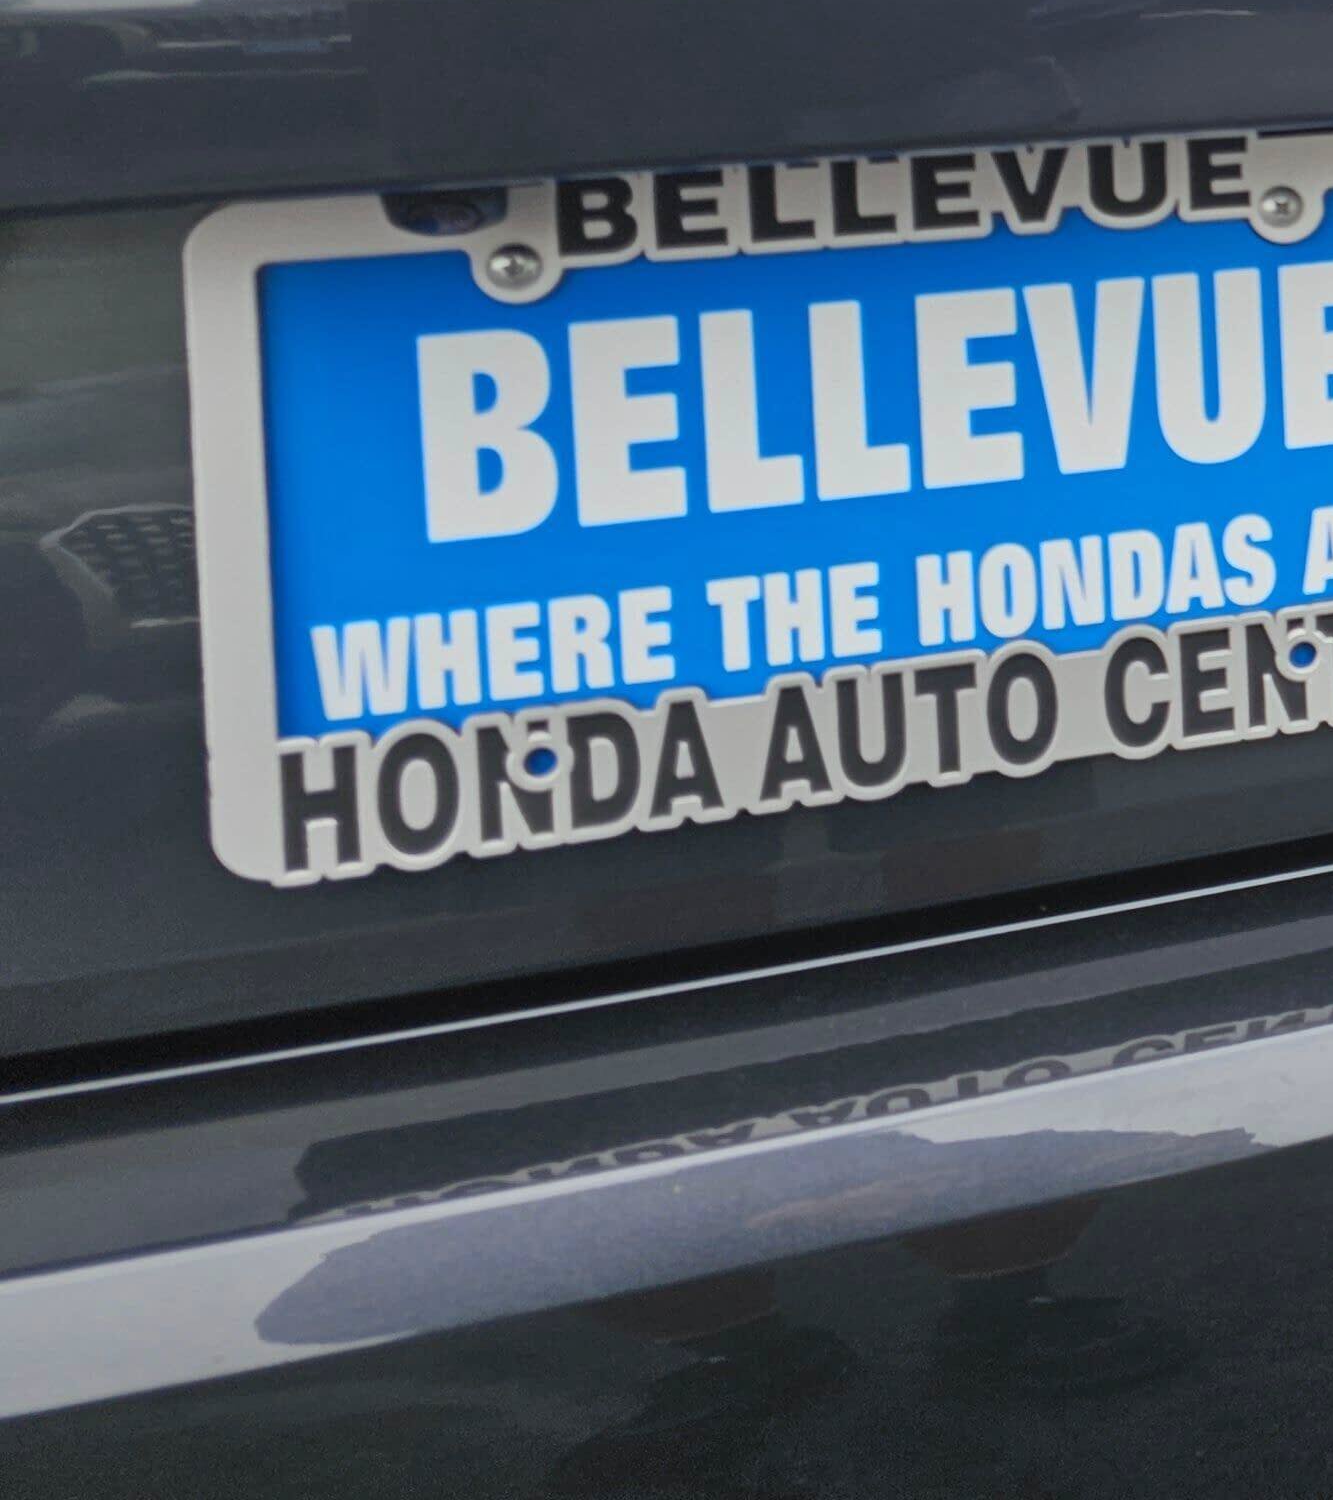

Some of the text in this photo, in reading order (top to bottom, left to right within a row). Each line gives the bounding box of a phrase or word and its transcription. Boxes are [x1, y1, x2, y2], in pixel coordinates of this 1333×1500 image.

[554, 136, 1252, 257] BELLEVUE
[311, 586, 676, 721] WHERE
[706, 561, 883, 672] THE
[916, 513, 1276, 646] HONDAS
[279, 700, 725, 872] HONDA
[759, 652, 1058, 801] AUTO
